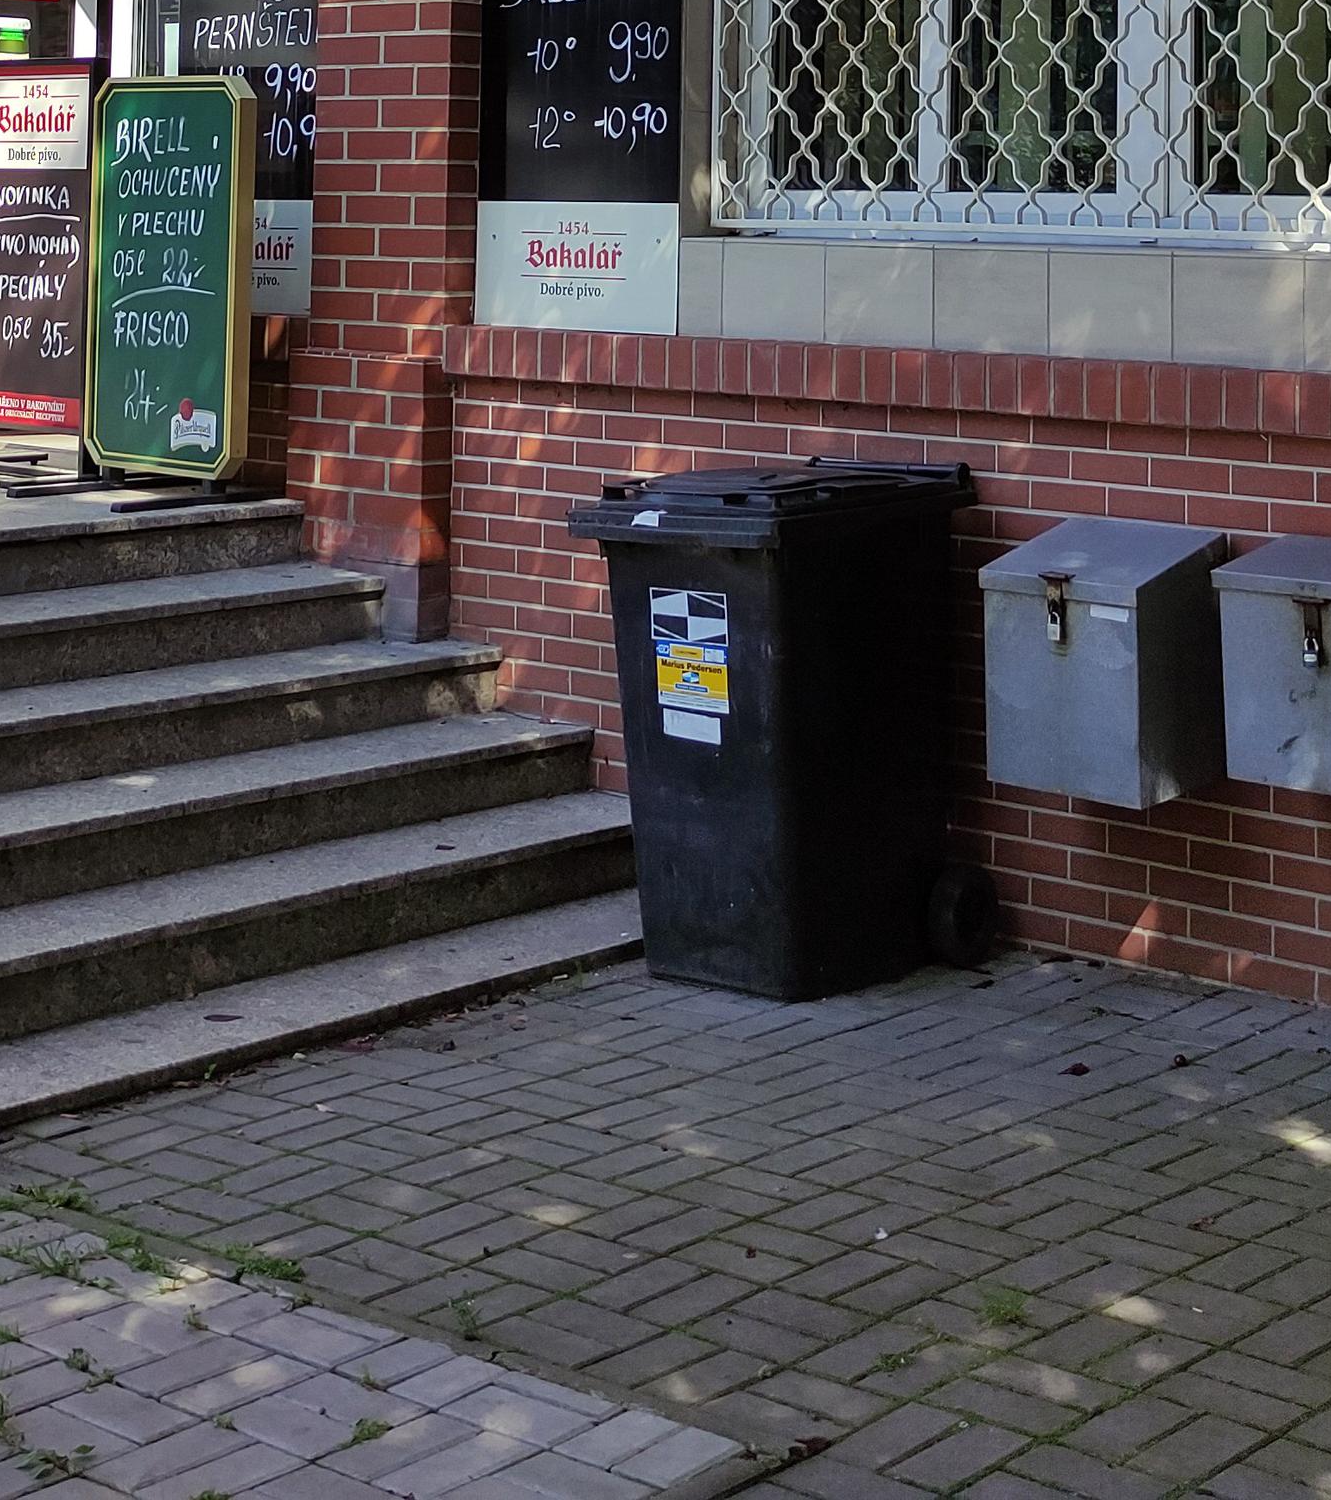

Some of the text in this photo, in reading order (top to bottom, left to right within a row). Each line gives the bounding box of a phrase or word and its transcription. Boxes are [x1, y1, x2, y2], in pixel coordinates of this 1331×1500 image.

[194, 2, 319, 50] PERNŠTEJ
[609, 21, 669, 83] 9,90
[22, 85, 49, 99] 1454
[265, 63, 316, 113] 9,90
[111, 116, 190, 167] BIRELL
[594, 102, 668, 155] 10,90
[7, 146, 62, 166] Dobré pivo.
[132, 209, 205, 237] PLECHU
[558, 221, 590, 235] 1454
[29, 224, 81, 269] NOMÁD
[525, 238, 623, 270] Bakalář
[540, 281, 605, 300] Dobré pivo.
[114, 310, 189, 348] FRISCO
[661, 658, 723, 675] Marius Pedersen
